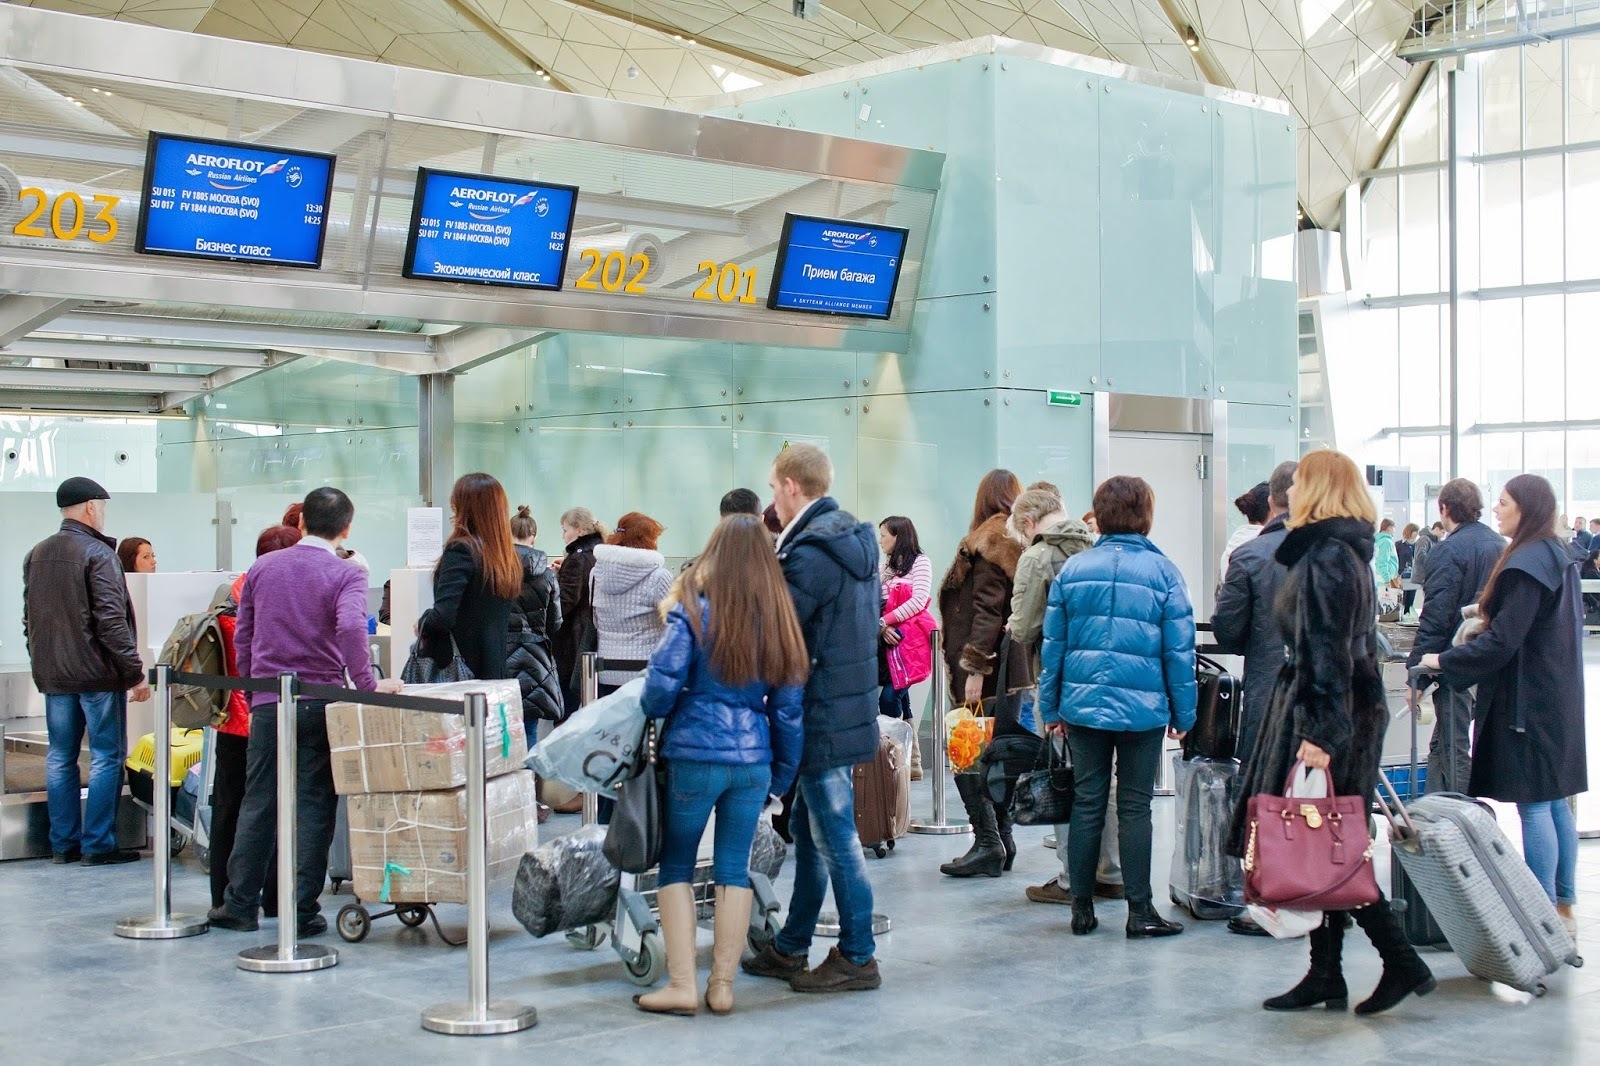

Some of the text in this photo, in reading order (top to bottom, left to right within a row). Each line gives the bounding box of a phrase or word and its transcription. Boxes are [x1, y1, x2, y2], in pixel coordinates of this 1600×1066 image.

[186, 153, 265, 173] AEROFLOT
[207, 170, 257, 184] Russian Airlines
[152, 187, 323, 214] SU 015 FV 1805 МОСКВА (SVO) 13:30
[450, 187, 517, 204] AEROFLOT
[13, 187, 121, 243] 203
[151, 200, 322, 225] SU 017 FV 1844 МОСКВА (SVO) 14:25
[468, 202, 511, 214] Russian Airlines
[420, 218, 429, 226] SU
[430, 219, 440, 228] 015
[445, 220, 454, 229] FV
[468, 222, 495, 234] МОСКВА
[495, 226, 512, 236] (SVO)
[822, 230, 859, 240] AEROFLOT
[196, 238, 271, 257] Бизнес класс
[418, 229, 427, 238] SU
[427, 230, 438, 239] 017
[444, 231, 452, 240] FV
[467, 234, 493, 245] МОСКВА
[493, 236, 510, 247] (SVO)
[549, 242, 564, 252] 14:25
[433, 262, 540, 282] Экономический класс
[575, 248, 650, 294] 202
[802, 264, 876, 284] Прием багажа
[693, 260, 757, 304] 201
[610, 734, 620, 747] &
